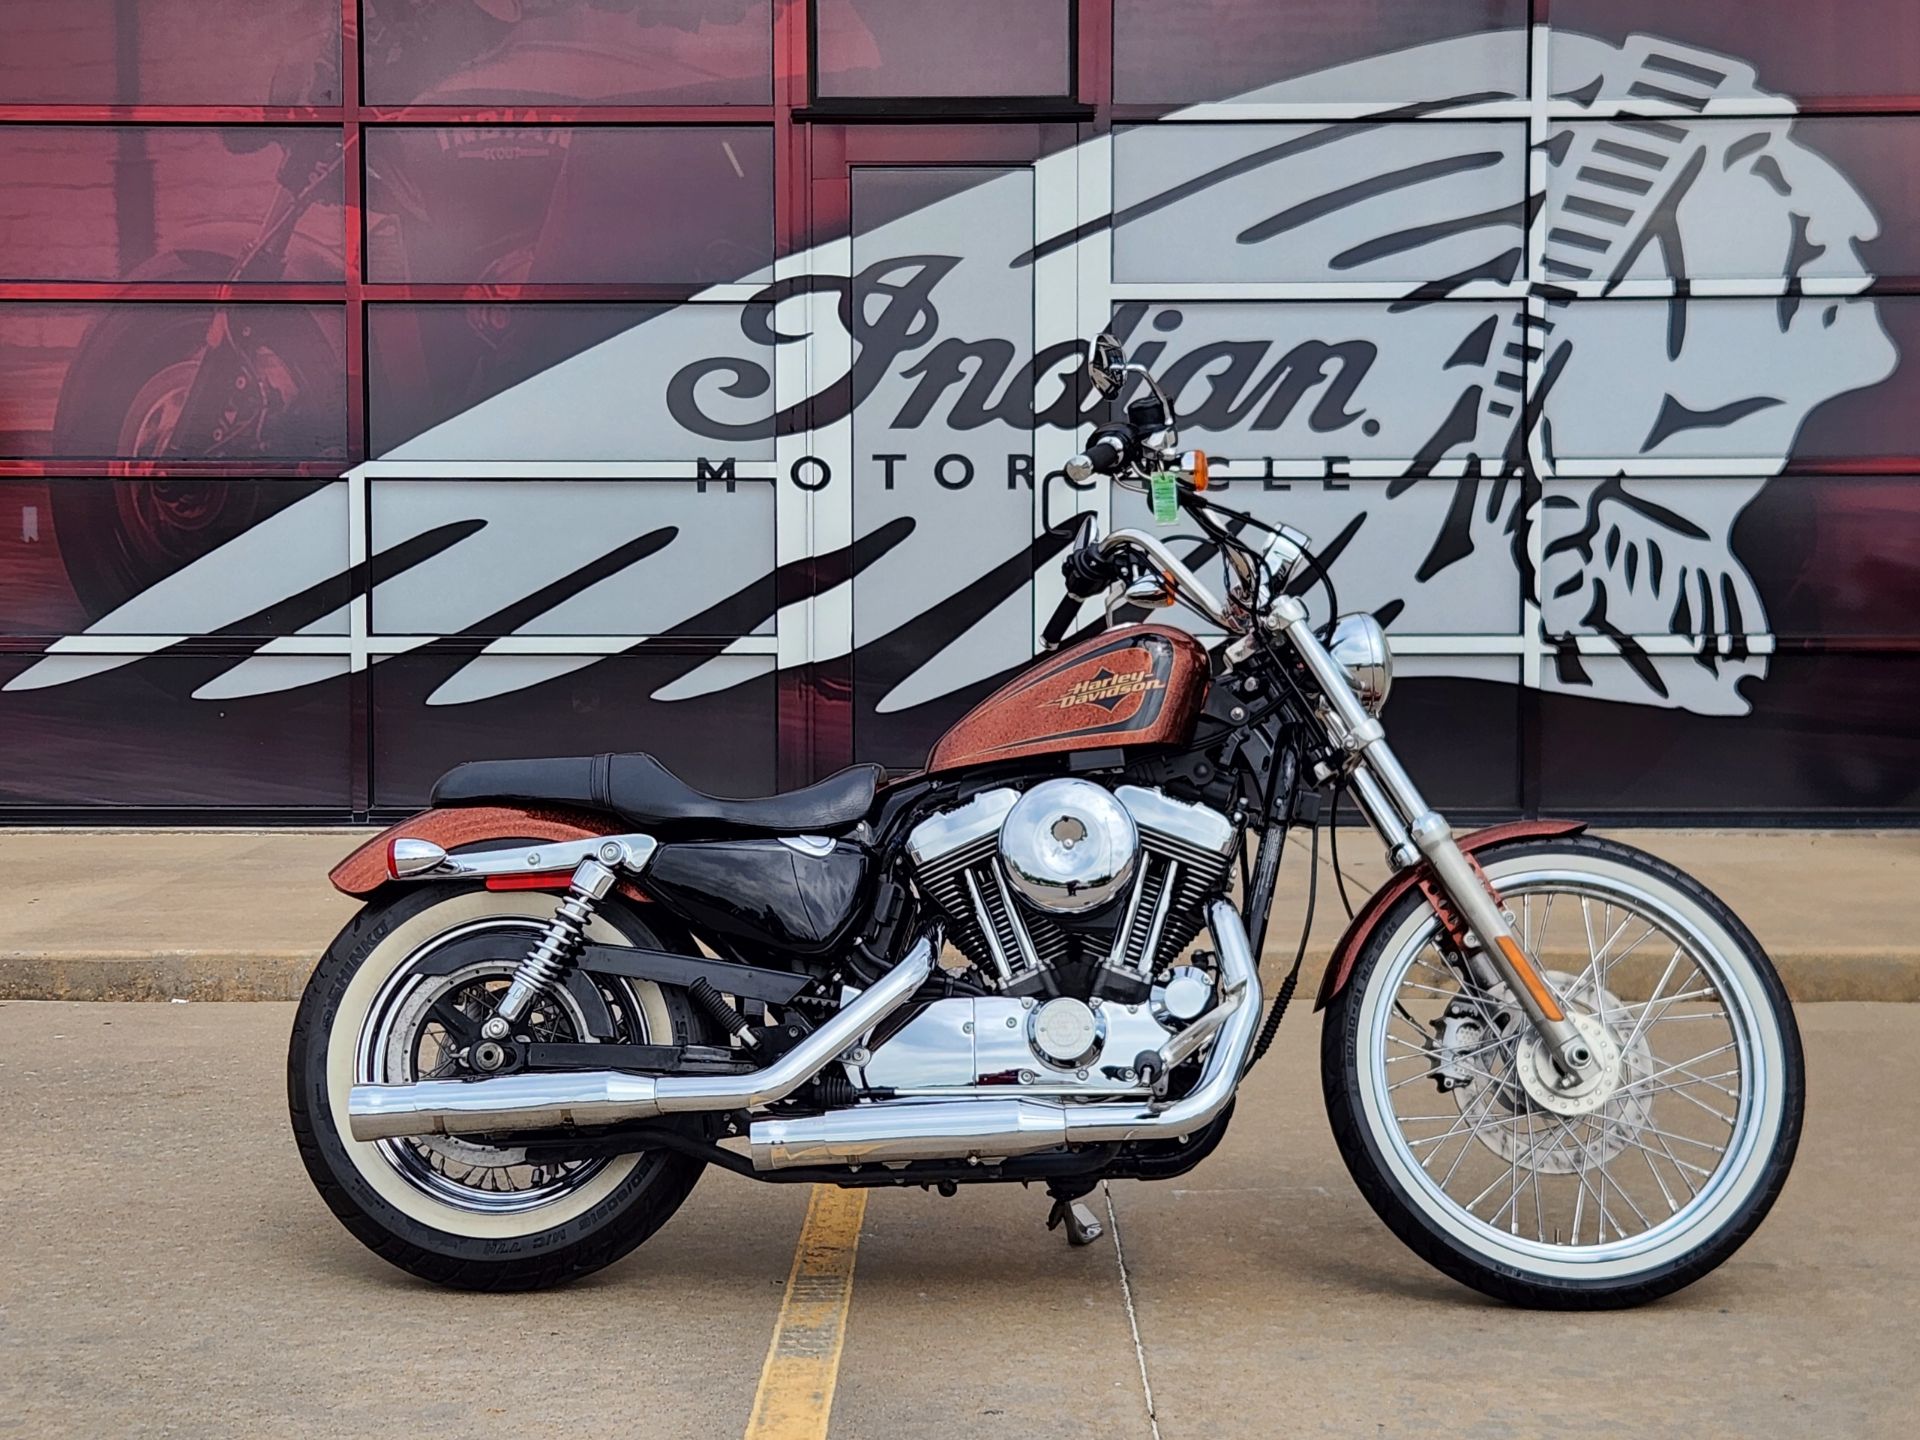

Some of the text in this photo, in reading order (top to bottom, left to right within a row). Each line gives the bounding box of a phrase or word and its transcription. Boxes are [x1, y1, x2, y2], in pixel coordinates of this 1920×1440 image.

[697, 454, 1350, 493] MOTORCLE
[1040, 678, 1165, 708] Davidson
[1063, 671, 1154, 697] Harley-
[327, 917, 389, 1002] SHINKO
